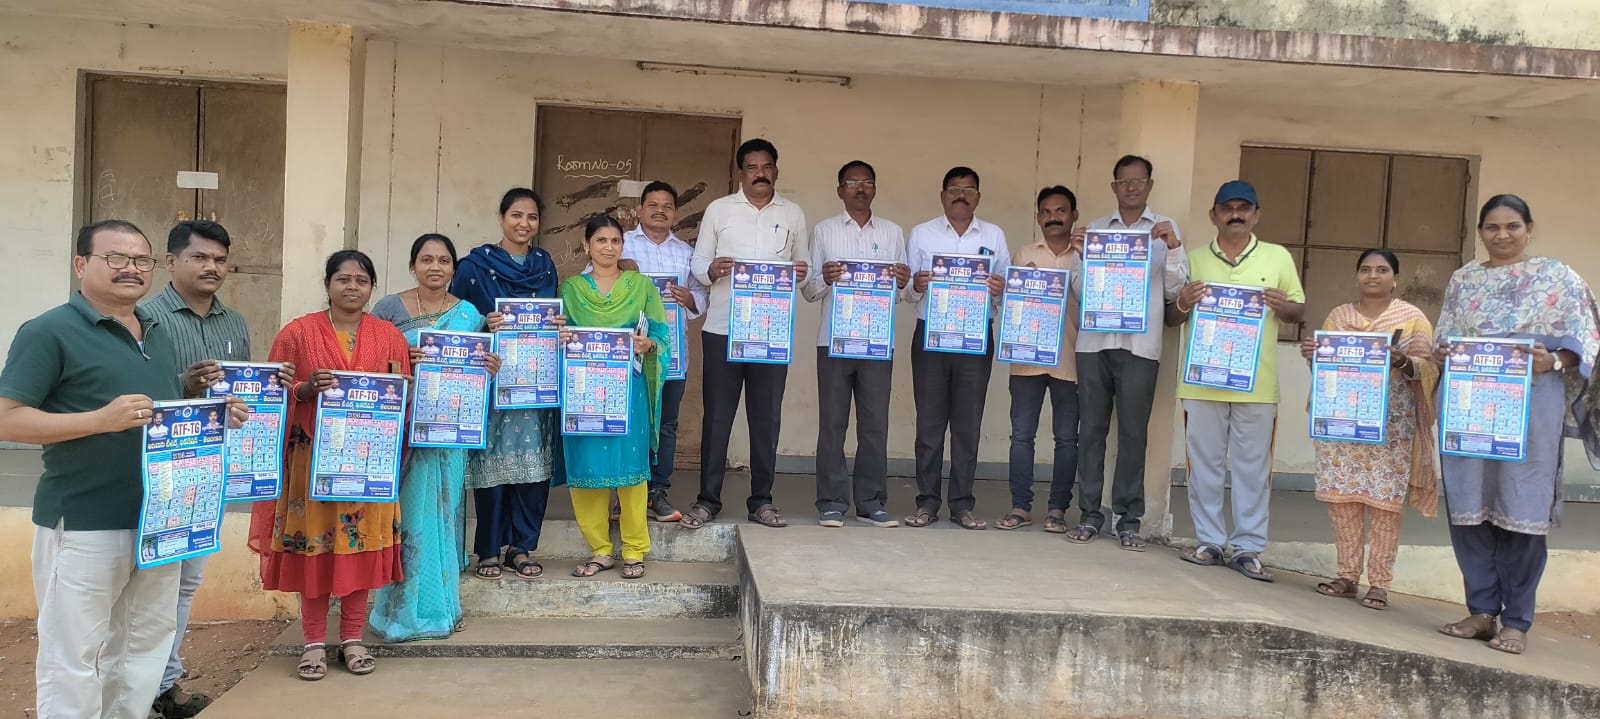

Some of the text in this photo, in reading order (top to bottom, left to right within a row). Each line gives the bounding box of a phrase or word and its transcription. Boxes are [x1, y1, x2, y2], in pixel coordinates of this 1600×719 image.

[557, 154, 591, 172] Room
[234, 381, 260, 393] ATF-TG
[349, 389, 377, 401] ATF-TG
[173, 421, 200, 436] ATF-TG
